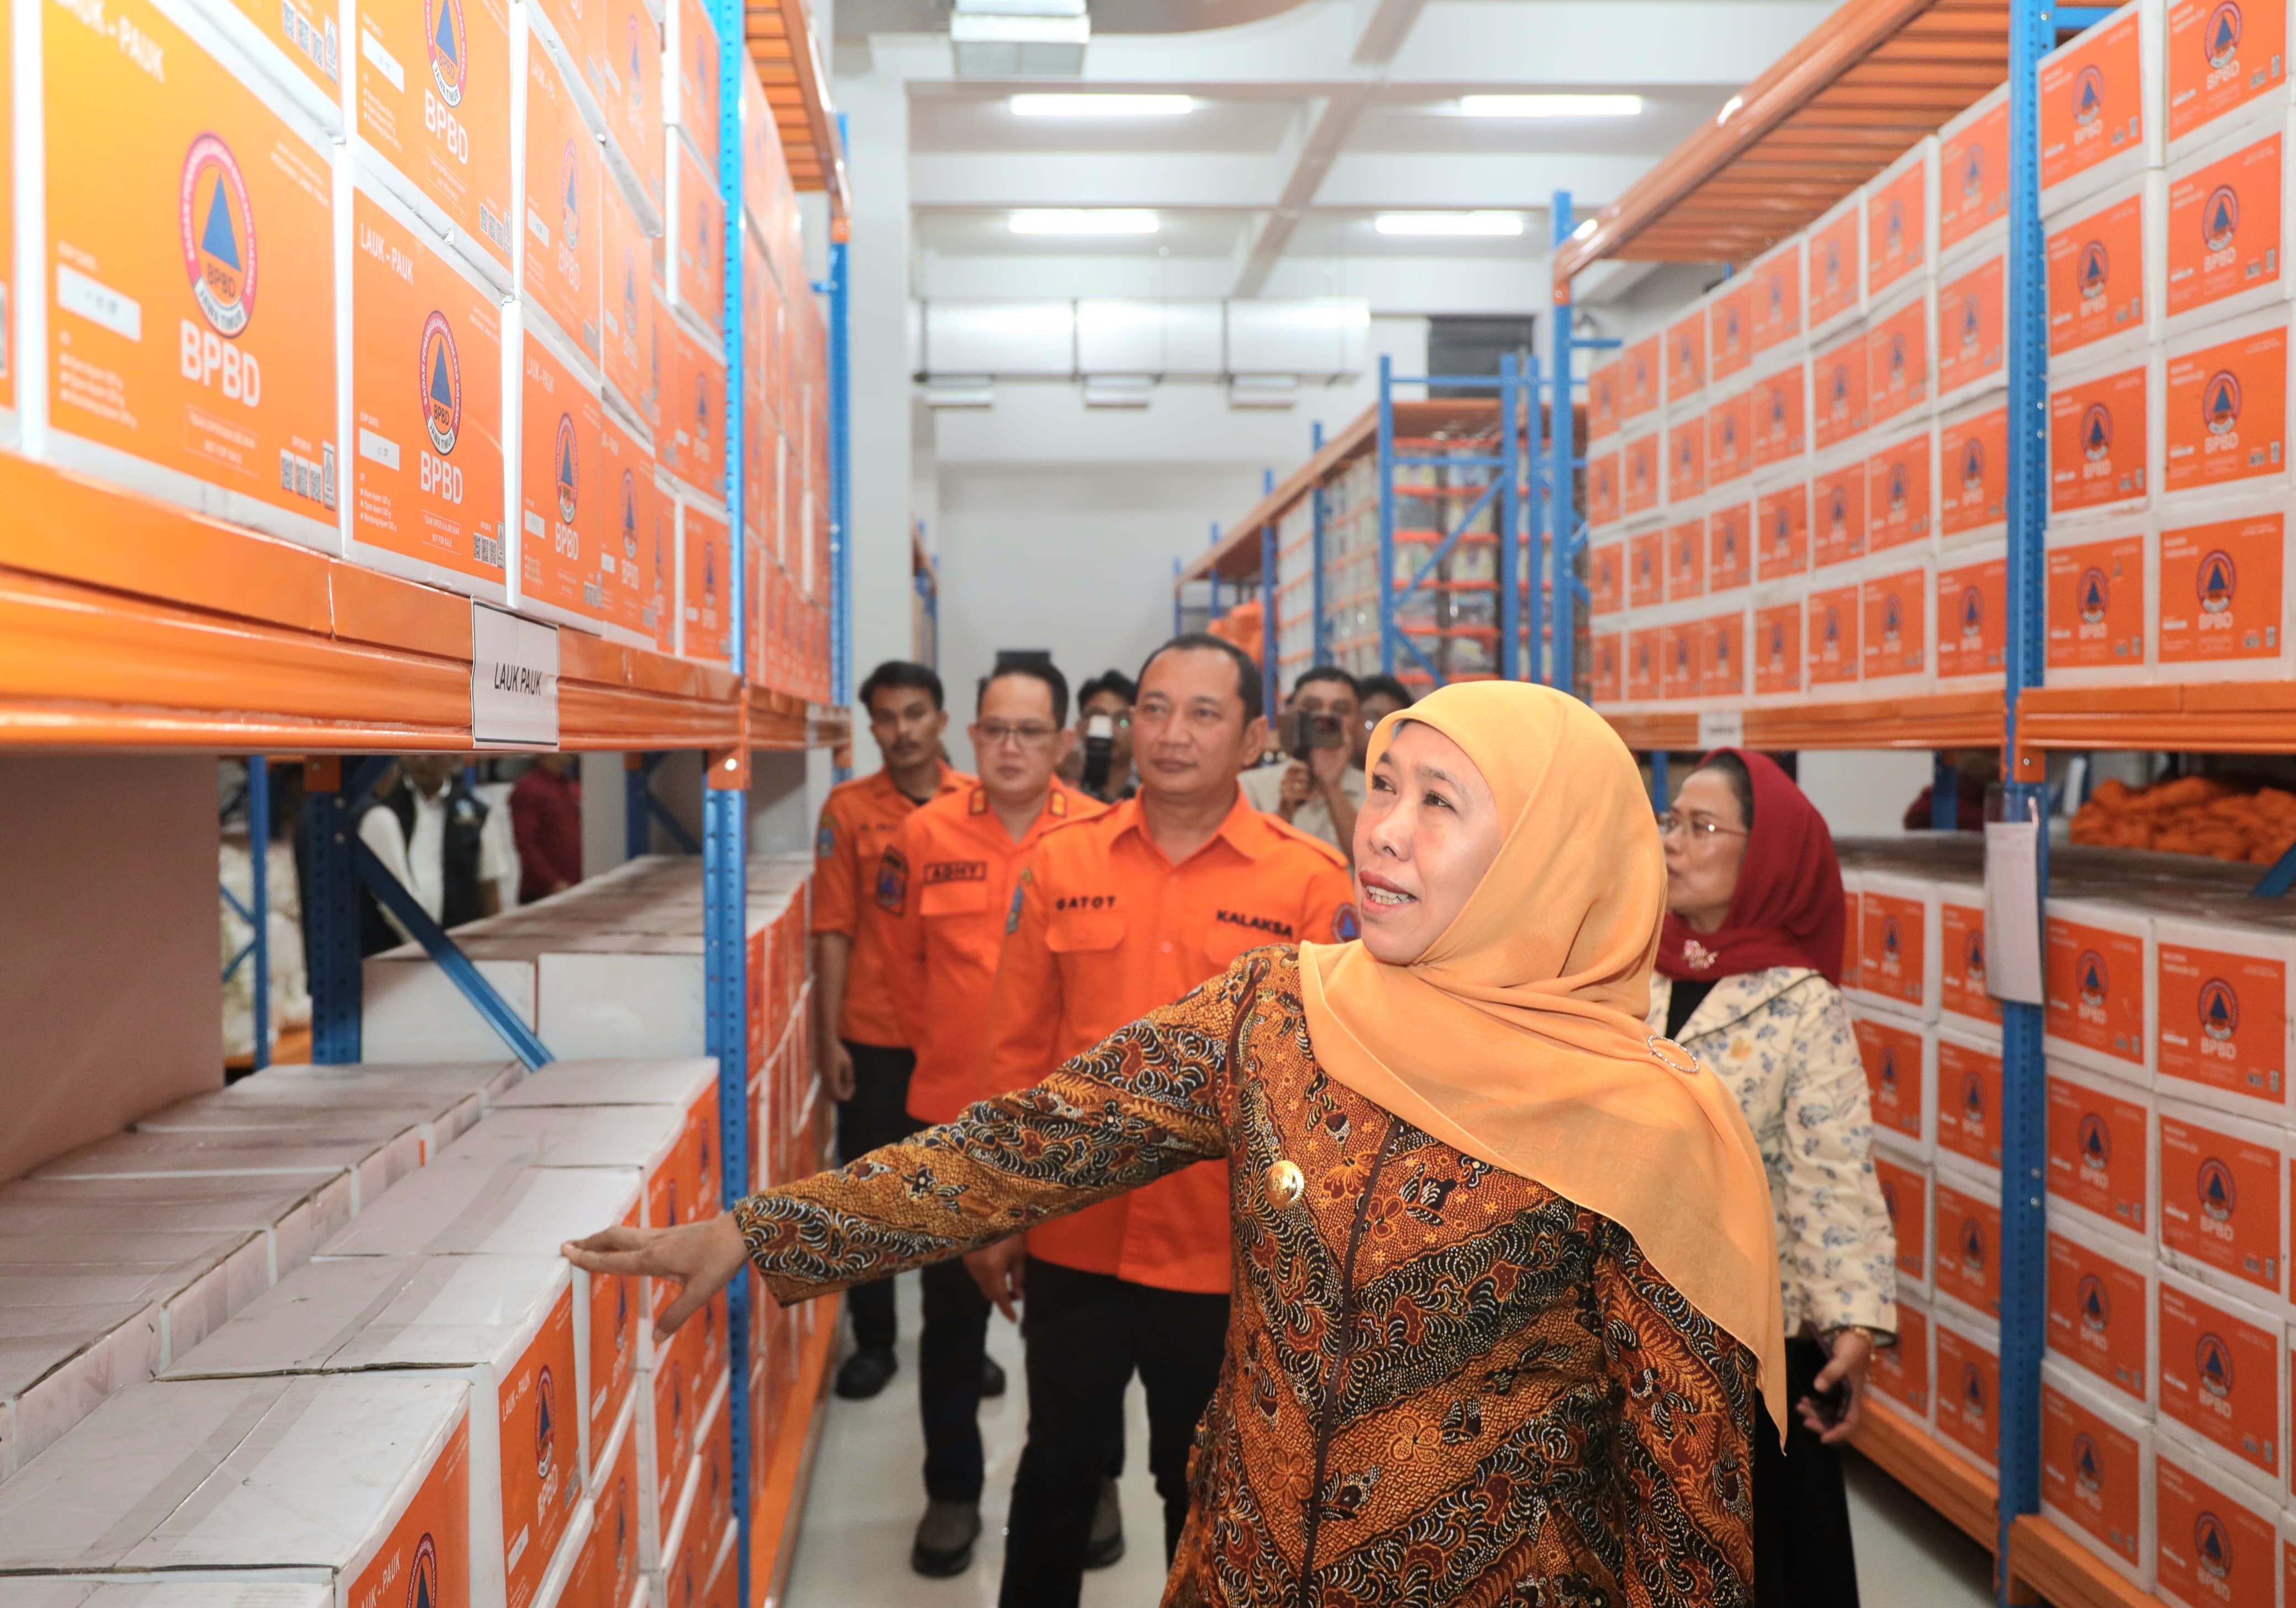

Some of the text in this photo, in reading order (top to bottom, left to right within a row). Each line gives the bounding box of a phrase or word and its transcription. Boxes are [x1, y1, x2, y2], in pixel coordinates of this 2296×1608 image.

[439, 50, 454, 79] BPBD
[434, 67, 459, 102] JAWA TIMUR
[425, 87, 468, 165] BPBD
[360, 221, 385, 263] LAUK
[391, 247, 413, 285] PAUK
[208, 262, 236, 298] BPBD
[180, 317, 260, 408] BPBD
[434, 403, 450, 426] BPBD
[429, 422, 453, 449] JAWA TIMUR
[421, 450, 463, 504] BPBD
[555, 521, 578, 561] BPBD
[494, 662, 541, 696] LAUK PAUK
[1056, 896, 1117, 911] GATOT
[1216, 909, 1293, 938] KALAKSA
[502, 1389, 515, 1422] LAUK
[518, 1369, 531, 1398] PAUK
[537, 1463, 558, 1527] BPBD
[382, 1547, 401, 1594] PAUK
